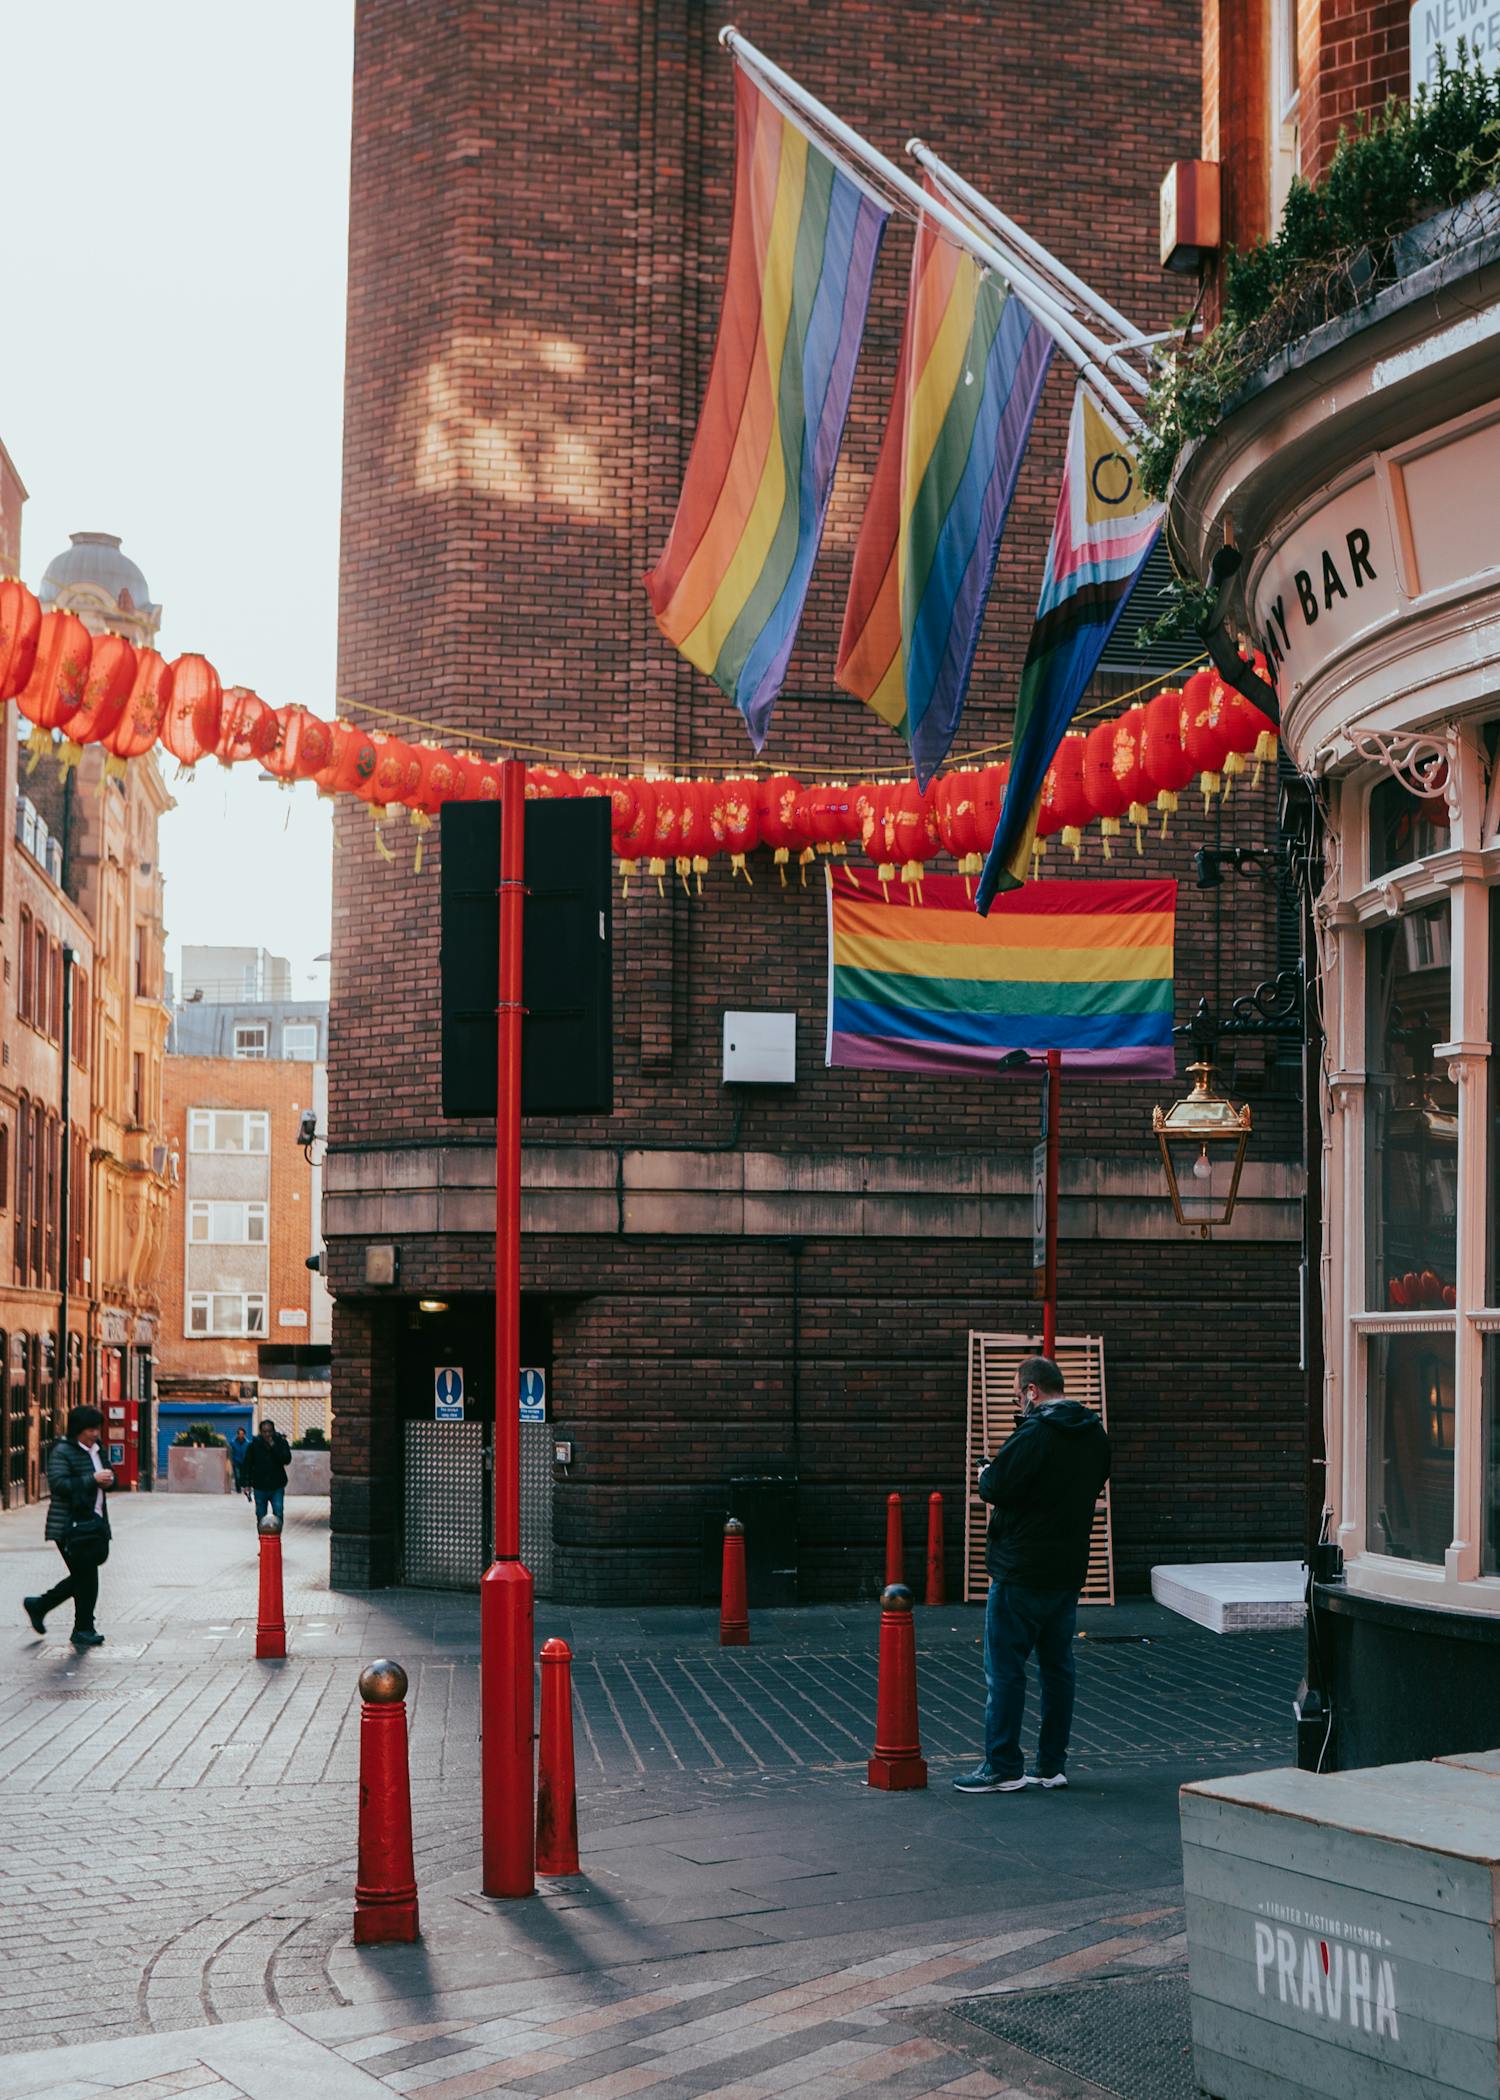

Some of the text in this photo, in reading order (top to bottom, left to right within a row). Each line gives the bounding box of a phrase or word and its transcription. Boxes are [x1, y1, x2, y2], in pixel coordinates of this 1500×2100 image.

[1294, 528, 1377, 626] BAR
[1304, 1911, 1341, 1937] TASTING
[1344, 1922, 1382, 1948] PILSNER
[1255, 1920, 1399, 2041] PRAVHA
